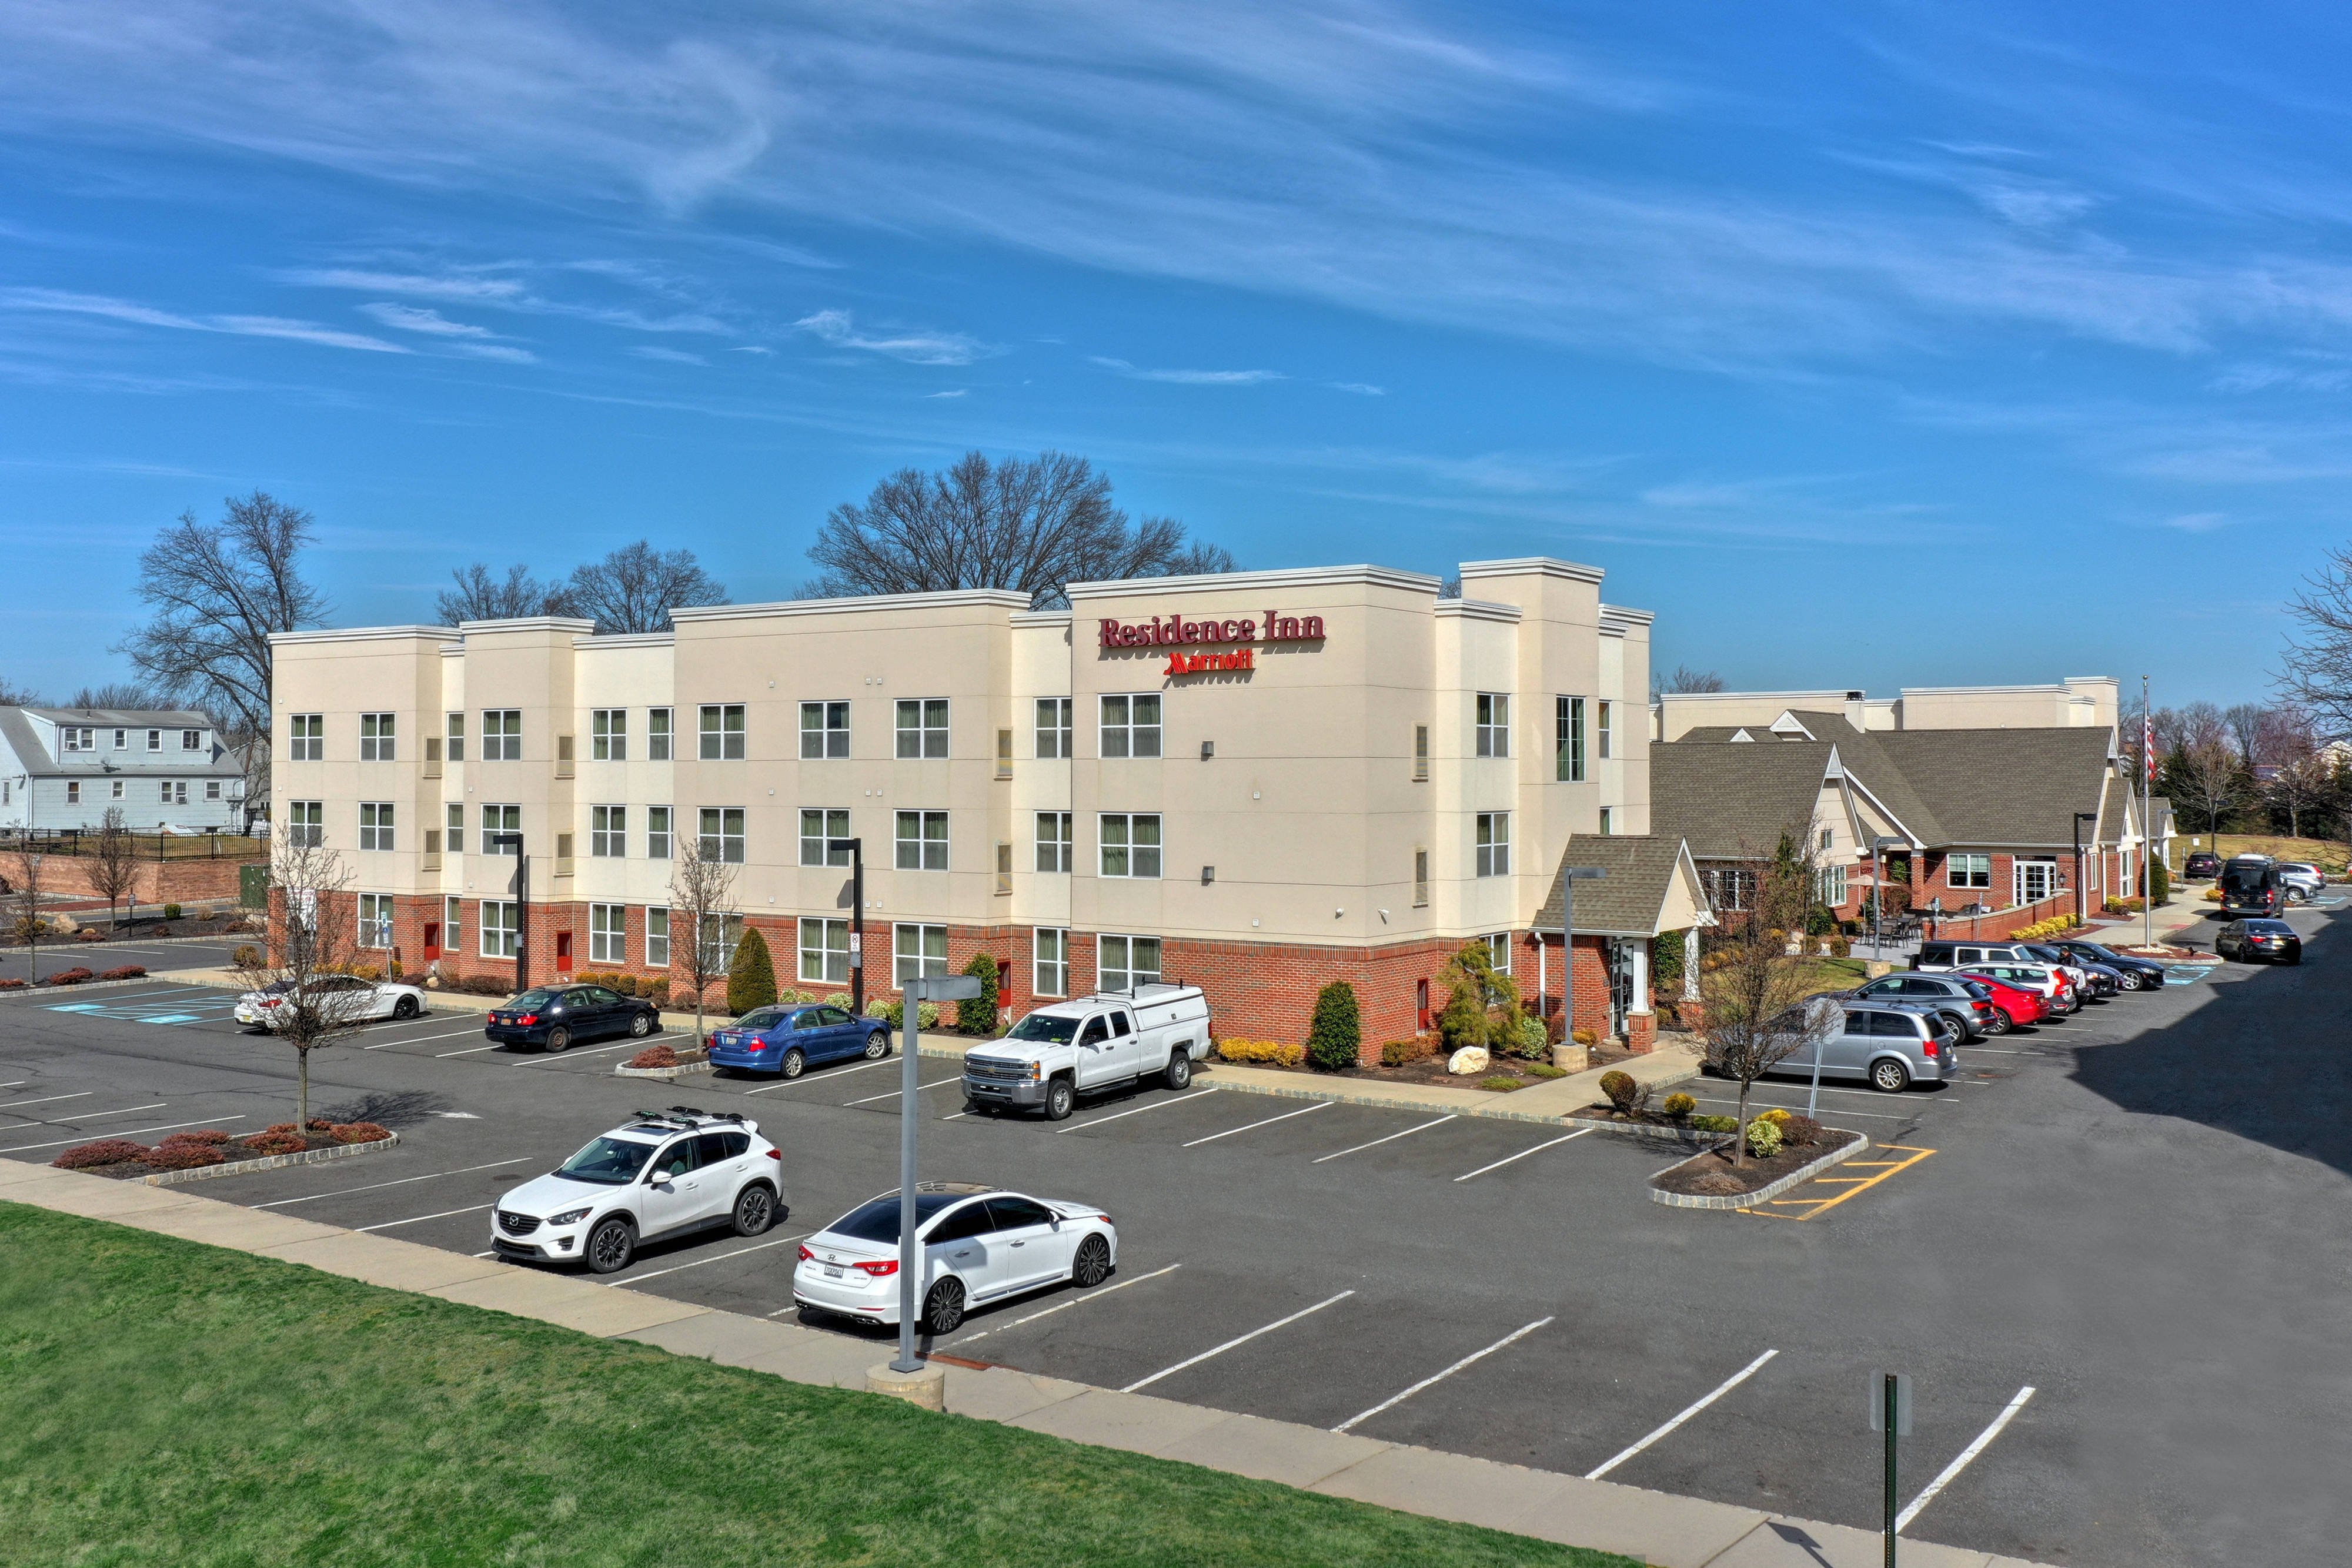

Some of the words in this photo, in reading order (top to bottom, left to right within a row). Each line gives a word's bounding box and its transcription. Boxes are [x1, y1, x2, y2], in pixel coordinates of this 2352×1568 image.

[1098, 614, 1255, 647] Residence
[1263, 610, 1326, 640] Inn
[1163, 648, 1255, 676] Marriott
